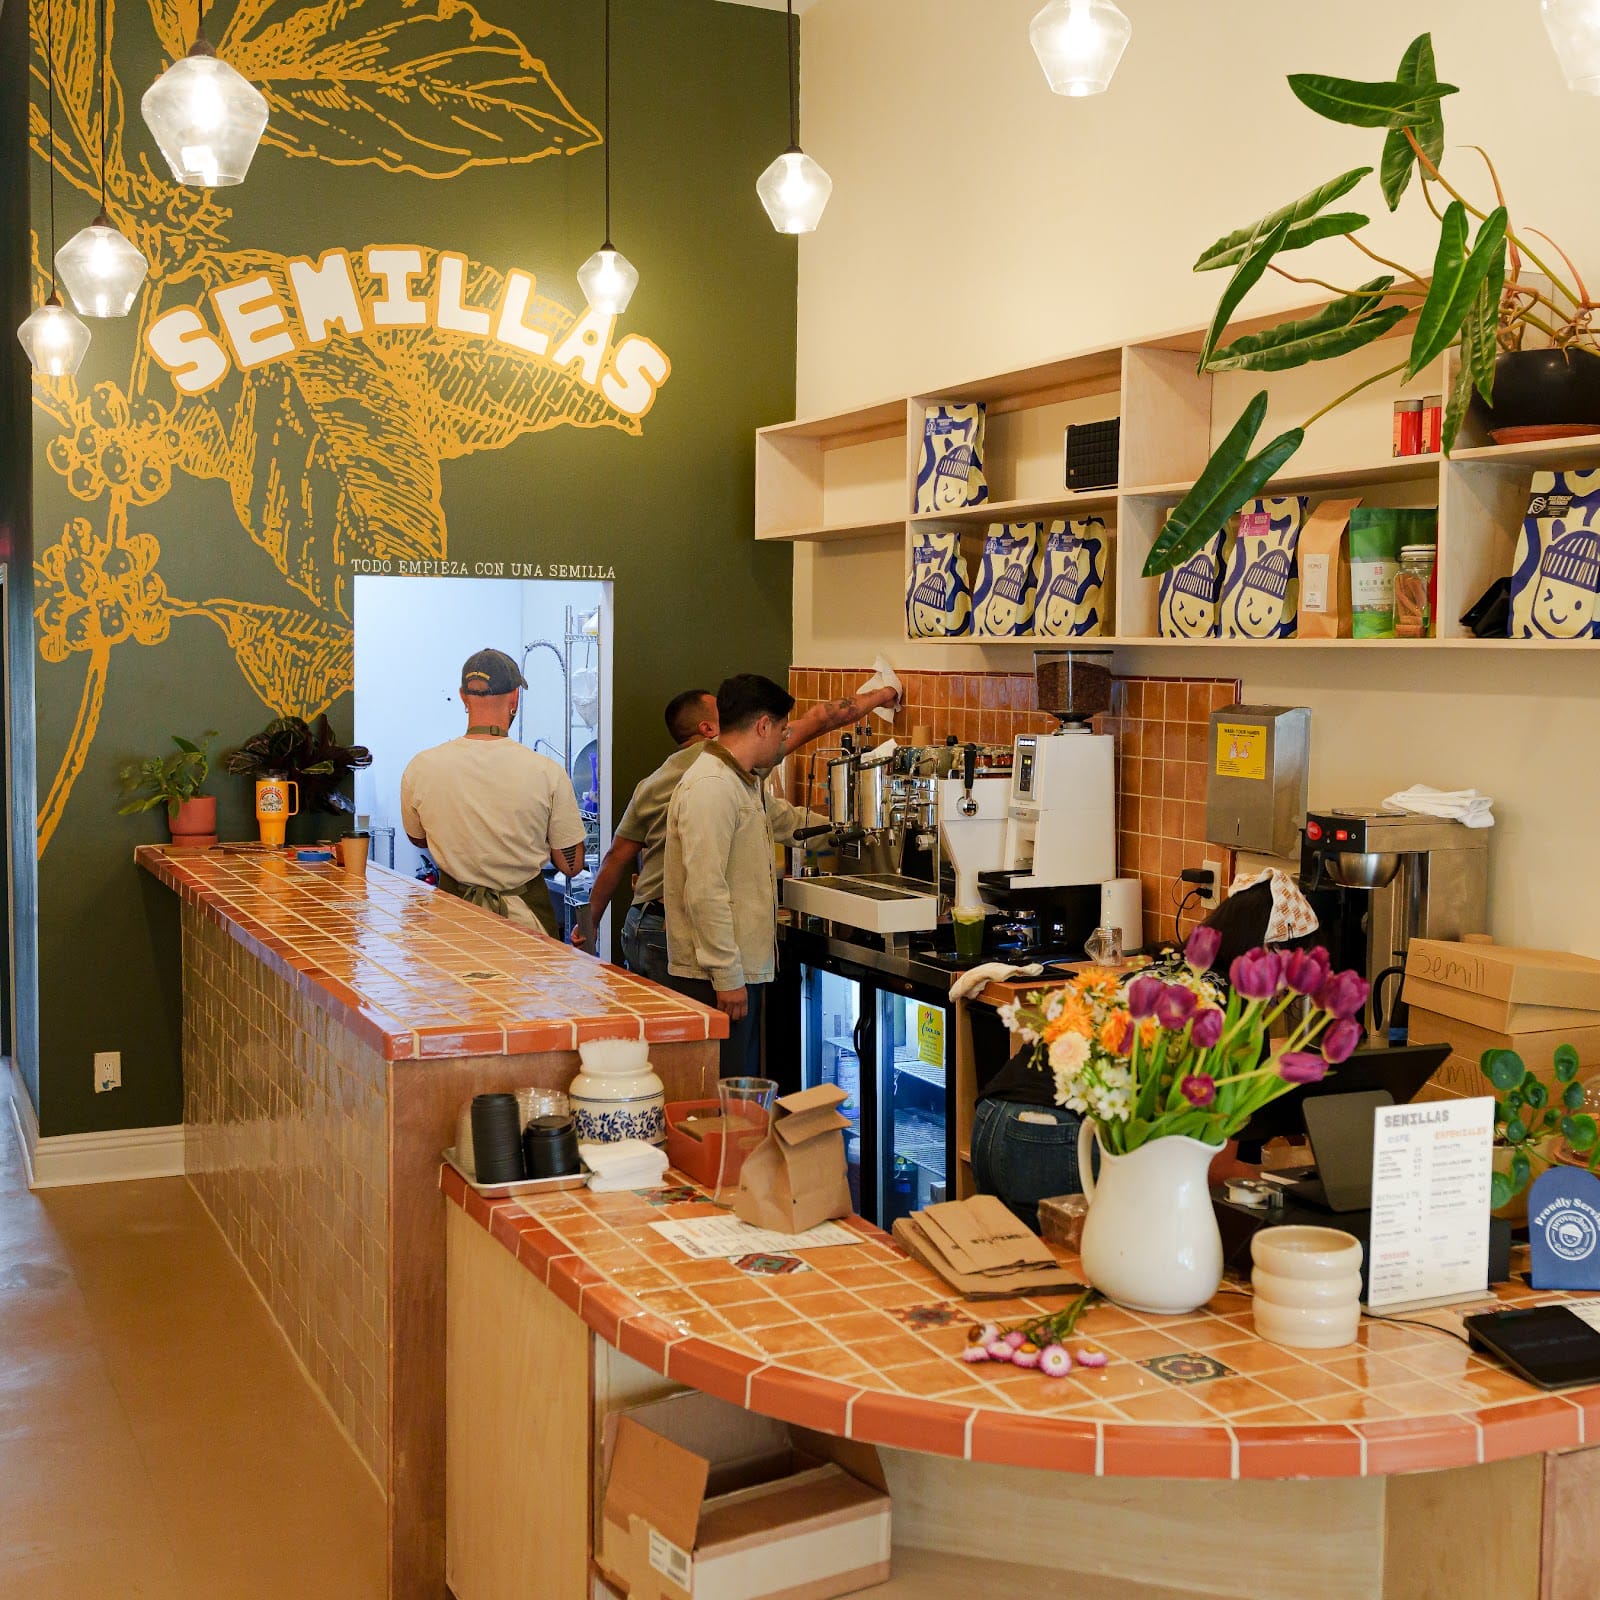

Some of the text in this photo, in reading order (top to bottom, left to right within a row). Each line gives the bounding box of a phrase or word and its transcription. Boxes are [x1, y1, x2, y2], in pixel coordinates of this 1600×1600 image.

[148, 248, 669, 415] SEMILLAS
[351, 559, 617, 580] TODO EMPIEZA CON UNA SEMILLA
[1413, 949, 1485, 989] Semill
[1384, 1109, 1450, 1128] SEMILLAS
[1534, 1197, 1572, 1226] Proudly
